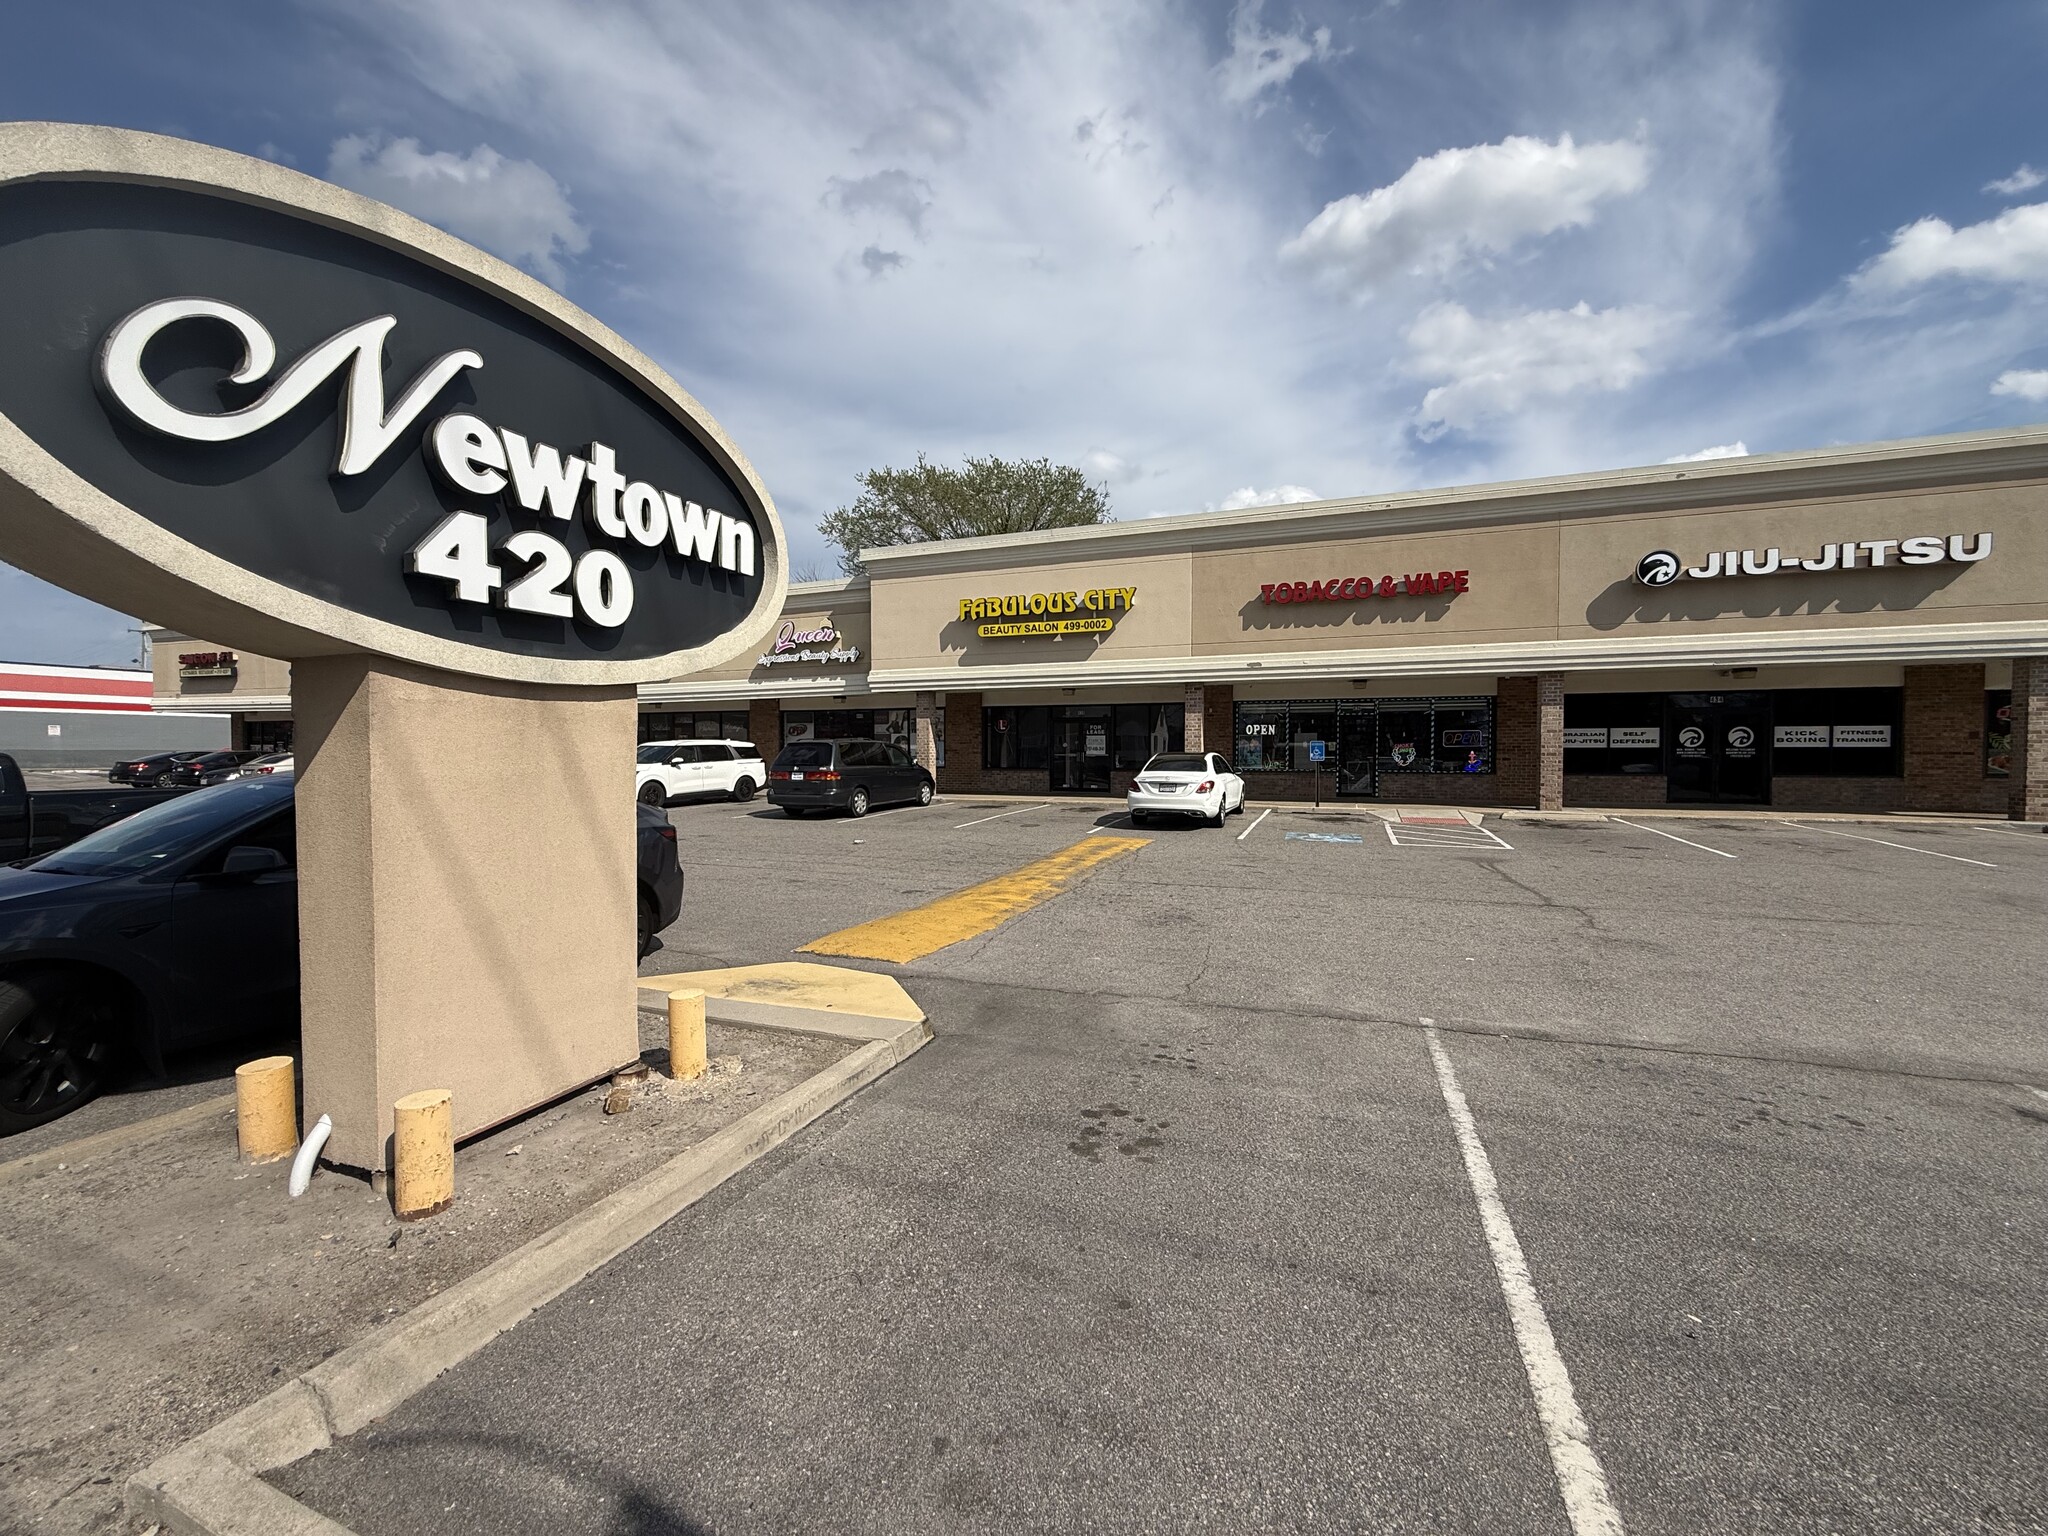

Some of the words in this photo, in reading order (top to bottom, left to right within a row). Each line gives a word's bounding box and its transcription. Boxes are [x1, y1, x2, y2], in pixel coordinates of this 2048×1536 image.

[101, 296, 756, 577] Newtown
[406, 510, 635, 628] 420
[1687, 531, 1993, 579] JIU-JITSU
[959, 591, 1077, 622] FABULOUS
[1083, 586, 1137, 612] CITY
[1260, 577, 1373, 605] TOBACCO
[1379, 575, 1398, 598] &
[1403, 570, 1469, 596] VAPE
[775, 620, 836, 653] Queen
[983, 624, 1022, 635] BEAUTY
[1024, 622, 1059, 633] SALON
[1063, 619, 1107, 631] 499-0002
[757, 652, 801, 667] Expressions
[800, 649, 830, 664] Beauty
[830, 646, 860, 662] Supply
[1245, 724, 1276, 735] OPEN
[1444, 733, 1480, 745] OPEN
[1263, 760, 1285, 769] VAPE
